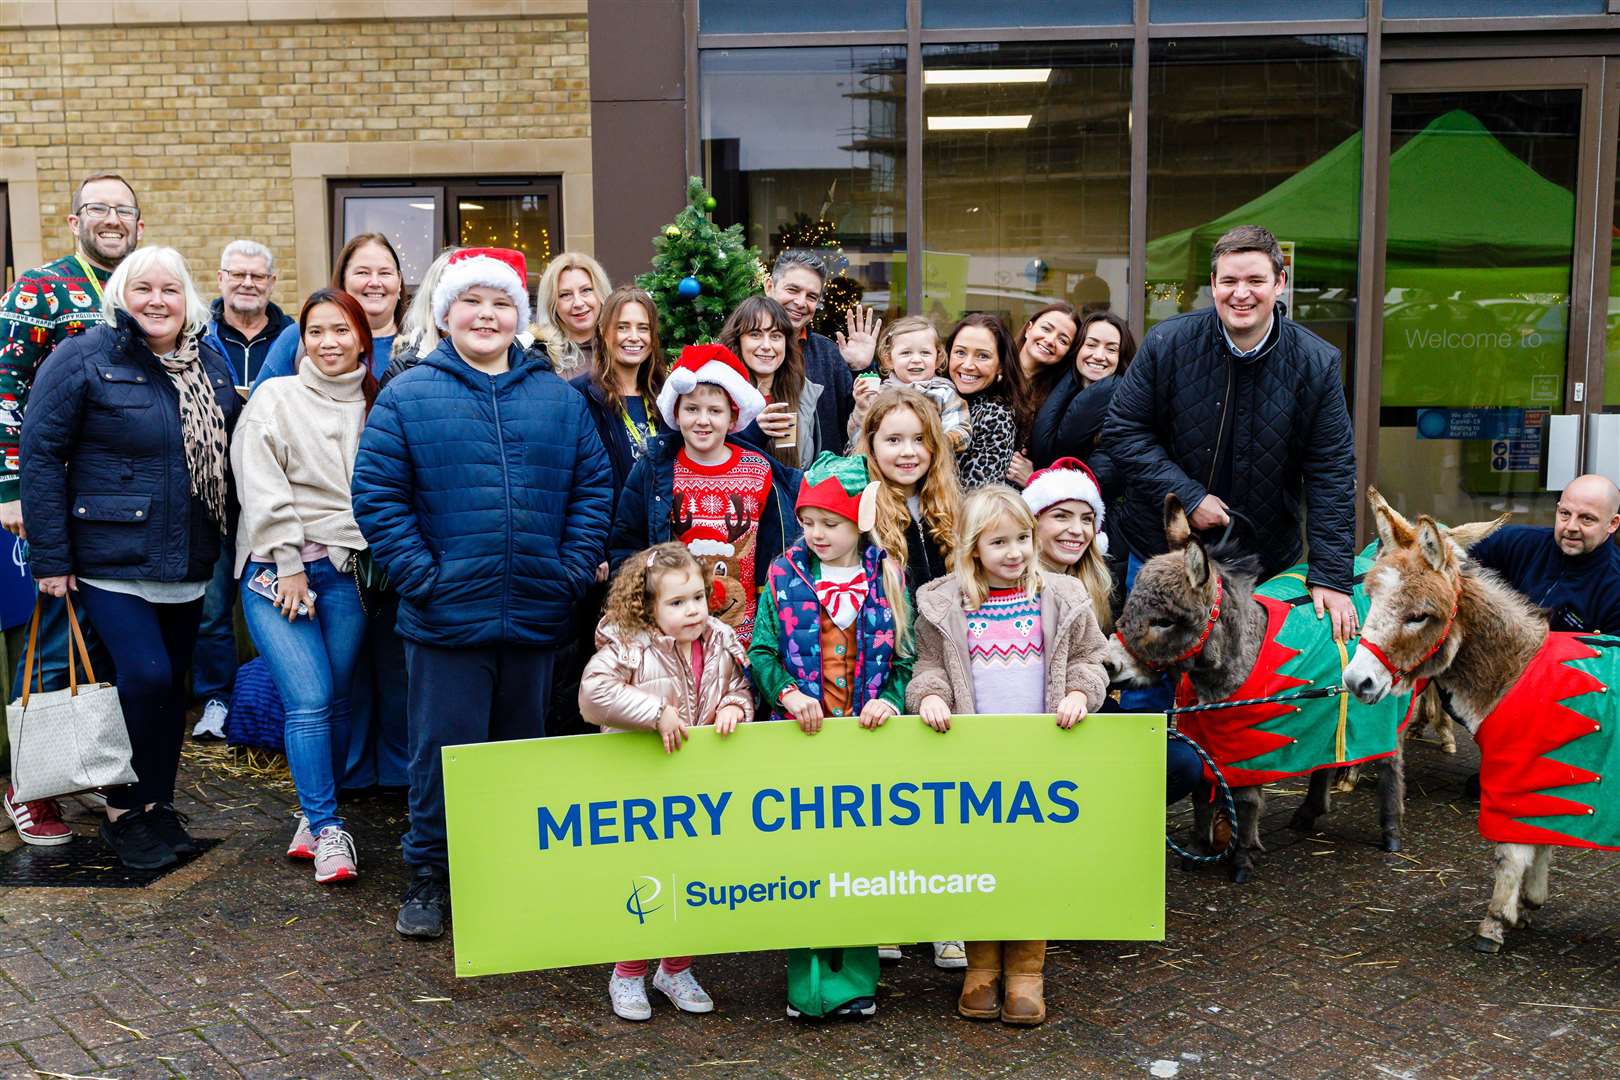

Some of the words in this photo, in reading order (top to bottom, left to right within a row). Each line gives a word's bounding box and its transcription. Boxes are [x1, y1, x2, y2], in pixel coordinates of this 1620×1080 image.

[1405, 328, 1512, 349] Welcome
[1520, 329, 1542, 349] to
[537, 791, 732, 849] MERRY
[751, 780, 1079, 833] CHRISTMAS
[685, 876, 822, 910] Superior
[828, 868, 997, 898] Healthcare
